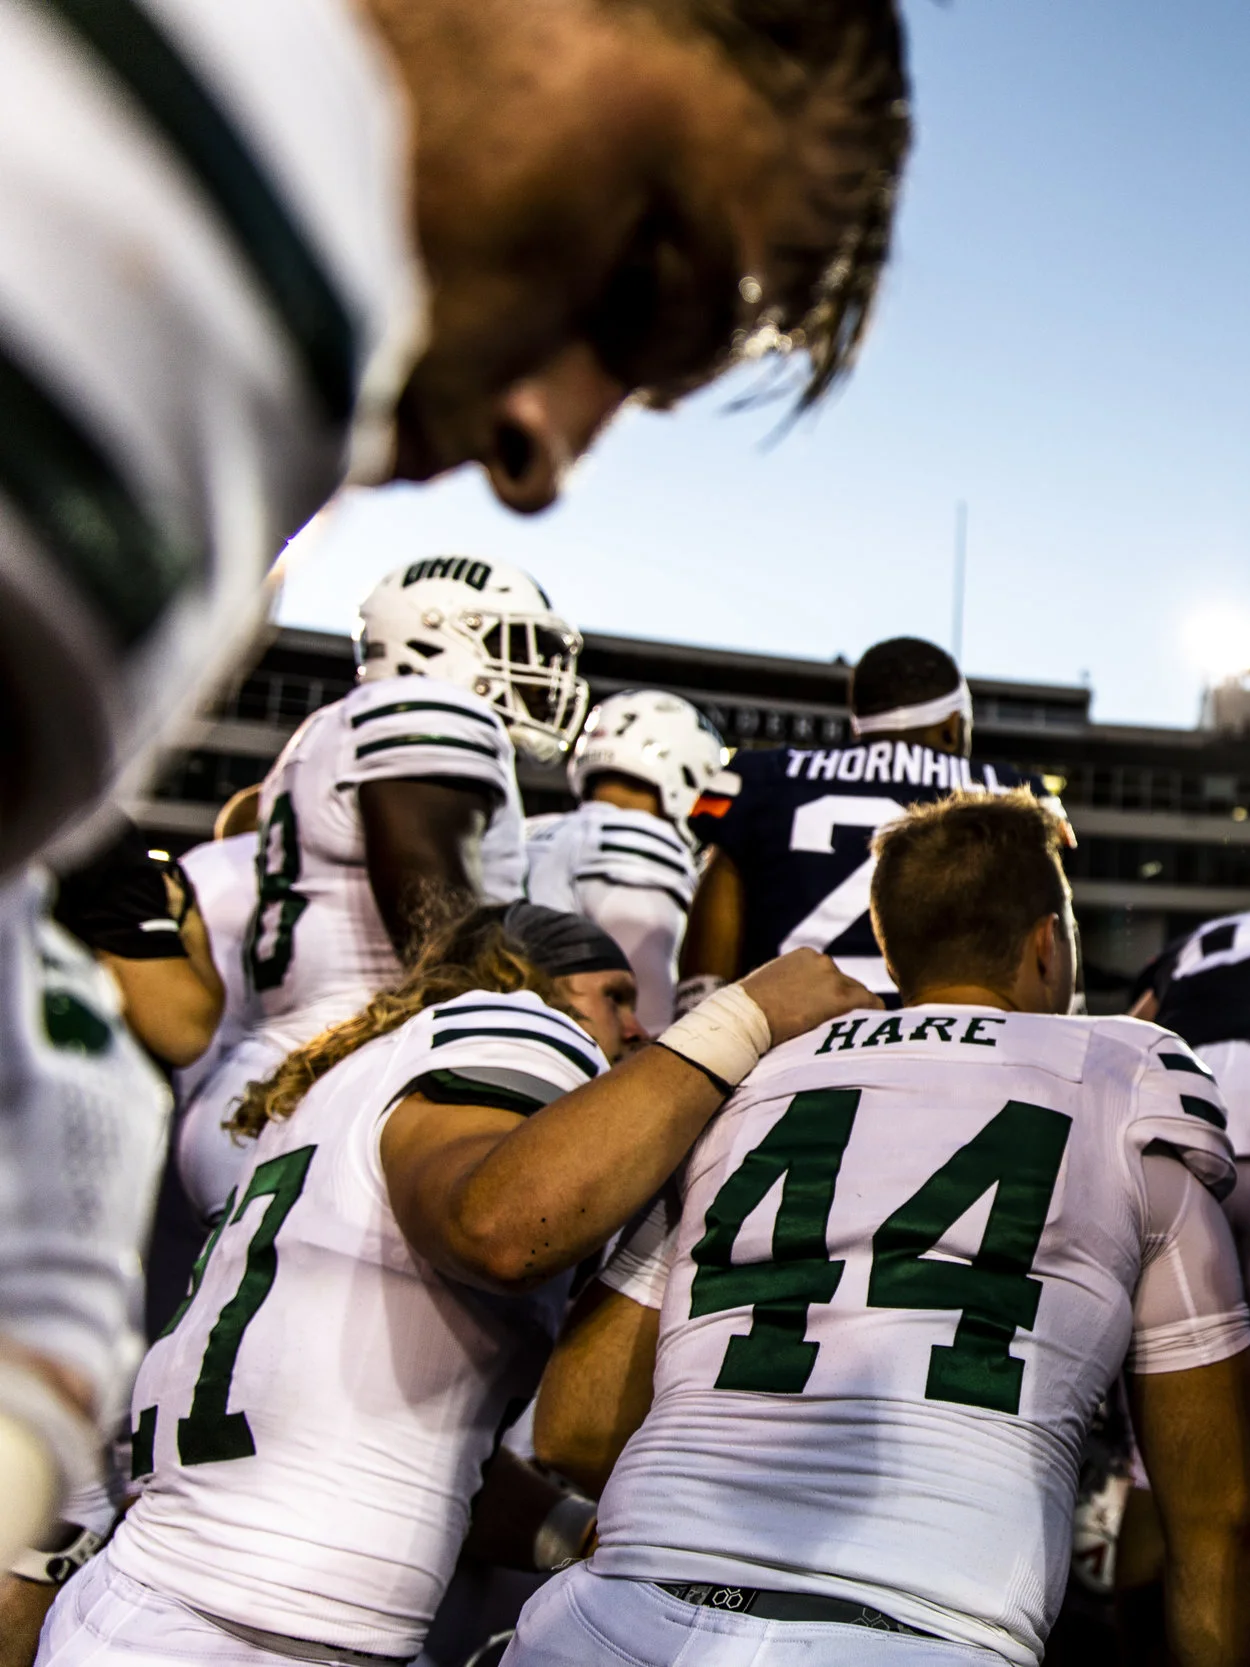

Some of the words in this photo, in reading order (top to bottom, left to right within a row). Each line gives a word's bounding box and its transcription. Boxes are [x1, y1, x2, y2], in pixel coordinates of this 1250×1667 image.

[785, 741, 1011, 795] THORNHILL
[813, 1016, 1006, 1056] HARE
[688, 1088, 1073, 1415] 44
